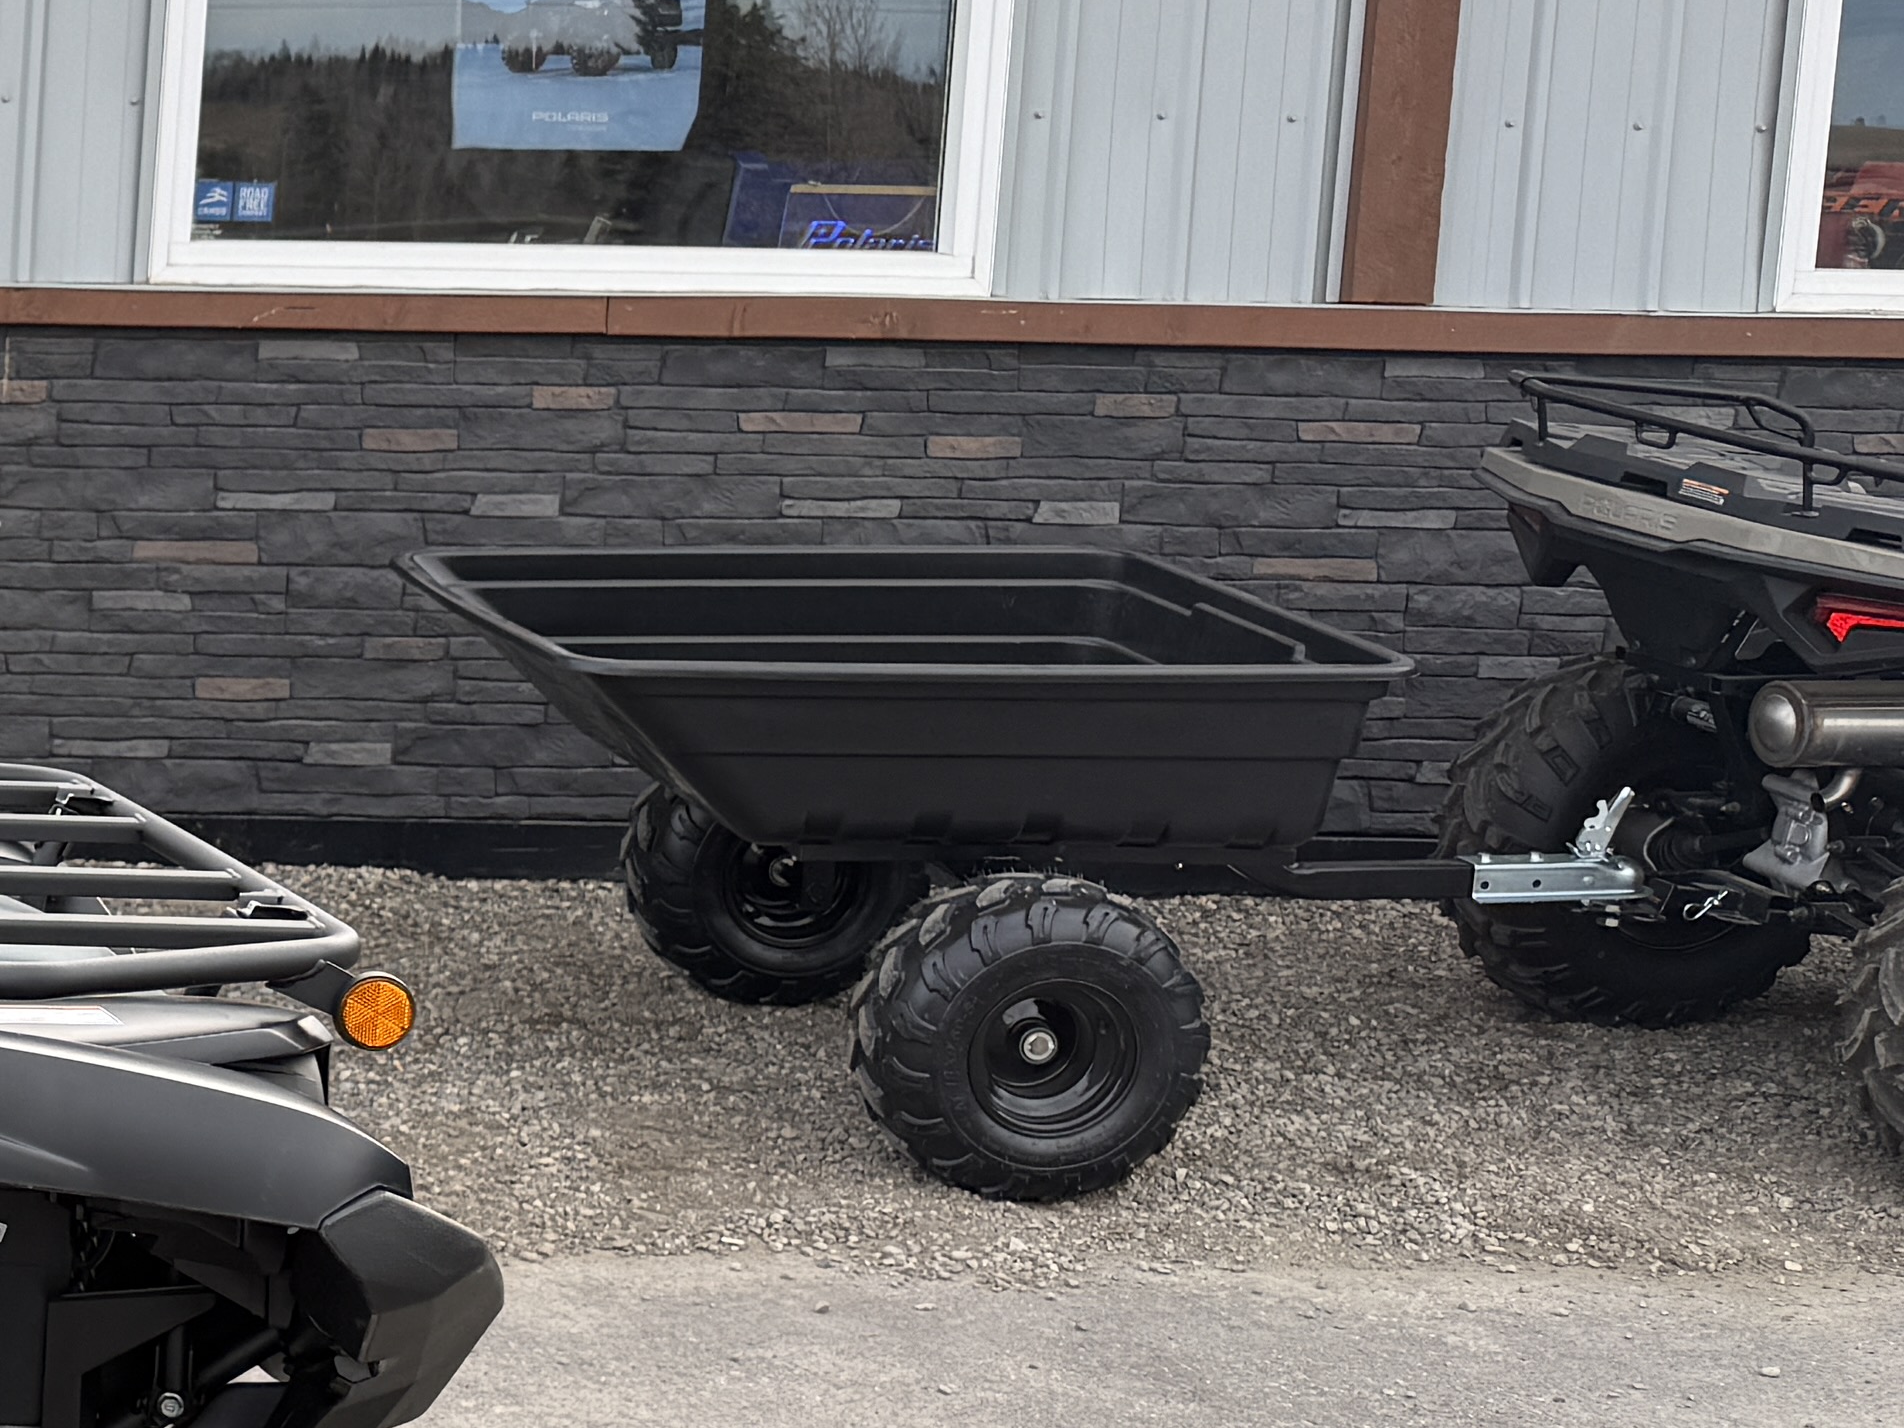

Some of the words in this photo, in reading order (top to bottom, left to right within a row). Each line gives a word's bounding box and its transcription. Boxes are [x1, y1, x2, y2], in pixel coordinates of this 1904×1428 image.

[532, 111, 609, 123] POLARIS
[239, 187, 268, 199] ROAD
[239, 198, 268, 210] FREE
